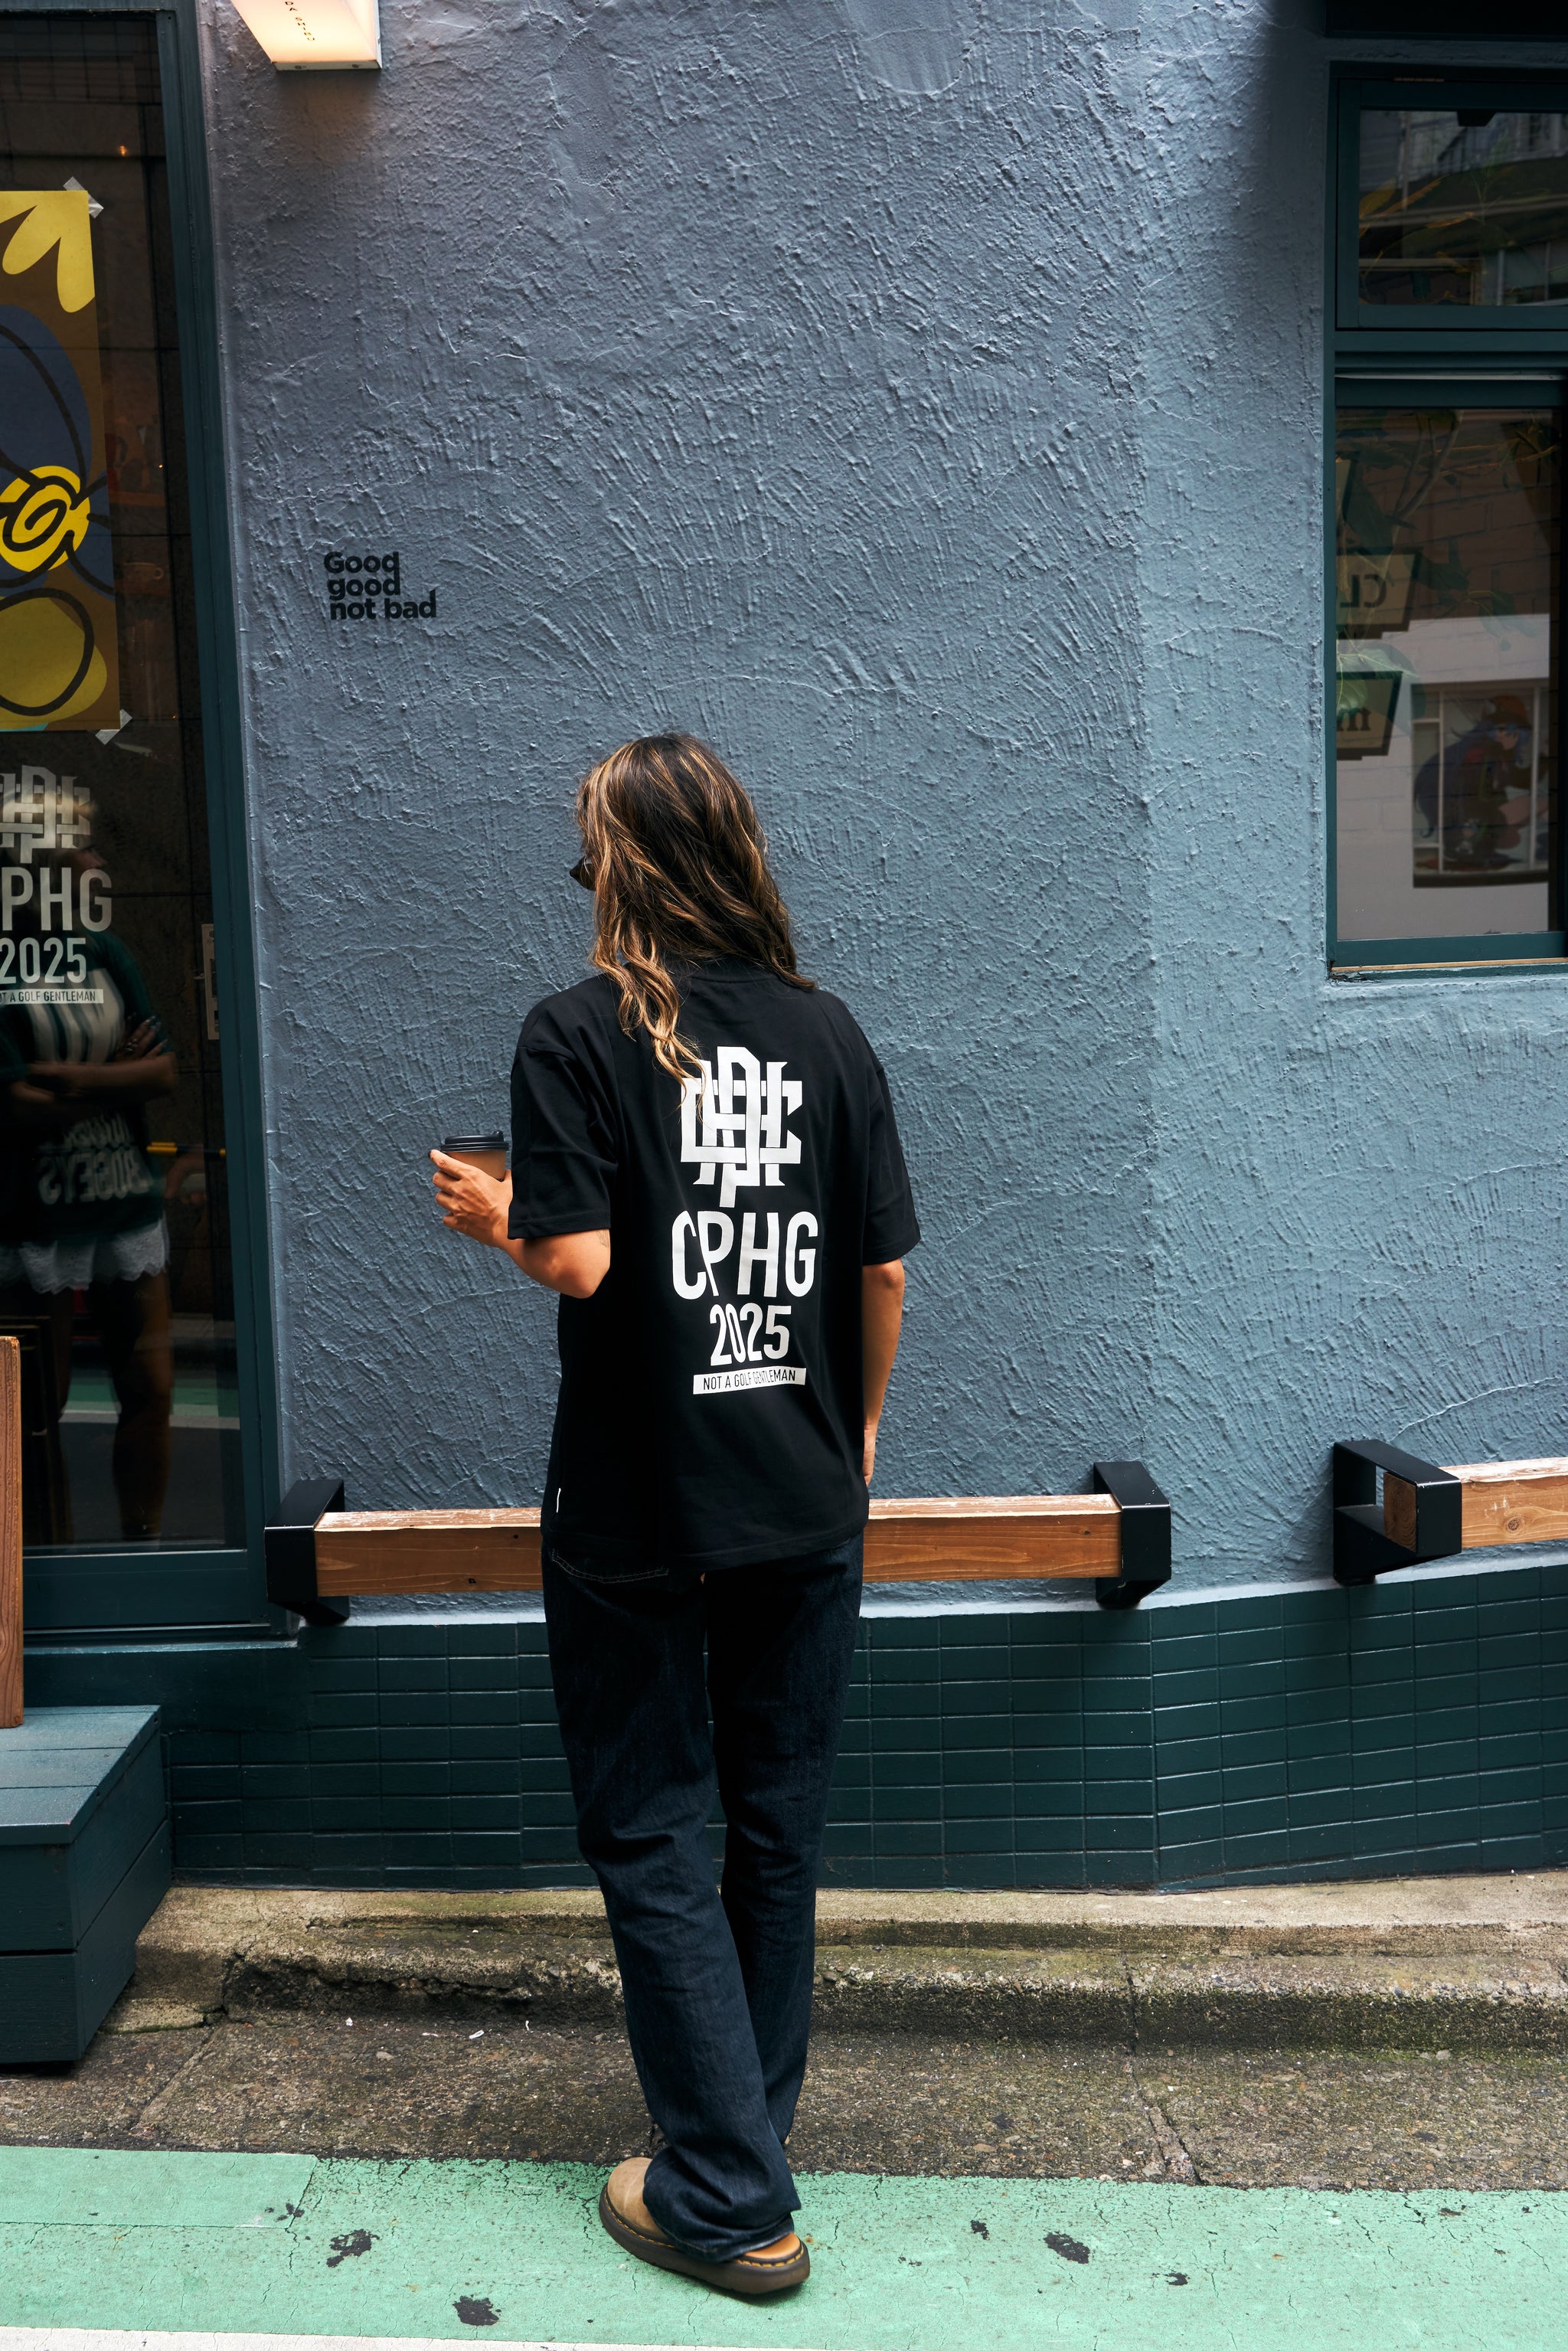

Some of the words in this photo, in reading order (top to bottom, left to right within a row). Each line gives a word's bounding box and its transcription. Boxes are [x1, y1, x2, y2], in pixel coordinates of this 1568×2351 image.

[324, 551, 400, 574] Good
[327, 572, 401, 600] good
[330, 598, 376, 620] not
[384, 588, 436, 619] bad
[0, 937, 87, 984] 2025
[10, 992, 16, 1002] A
[18, 991, 41, 1002] GOLF
[44, 990, 96, 1002] GENTLEMAN
[671, 1210, 818, 1300] CPHG
[709, 1303, 792, 1366] 2025
[703, 1375, 722, 1391] NOT
[724, 1375, 731, 1388] A
[734, 1372, 752, 1388] GOLF
[753, 1368, 796, 1385] GENTLEMAN
